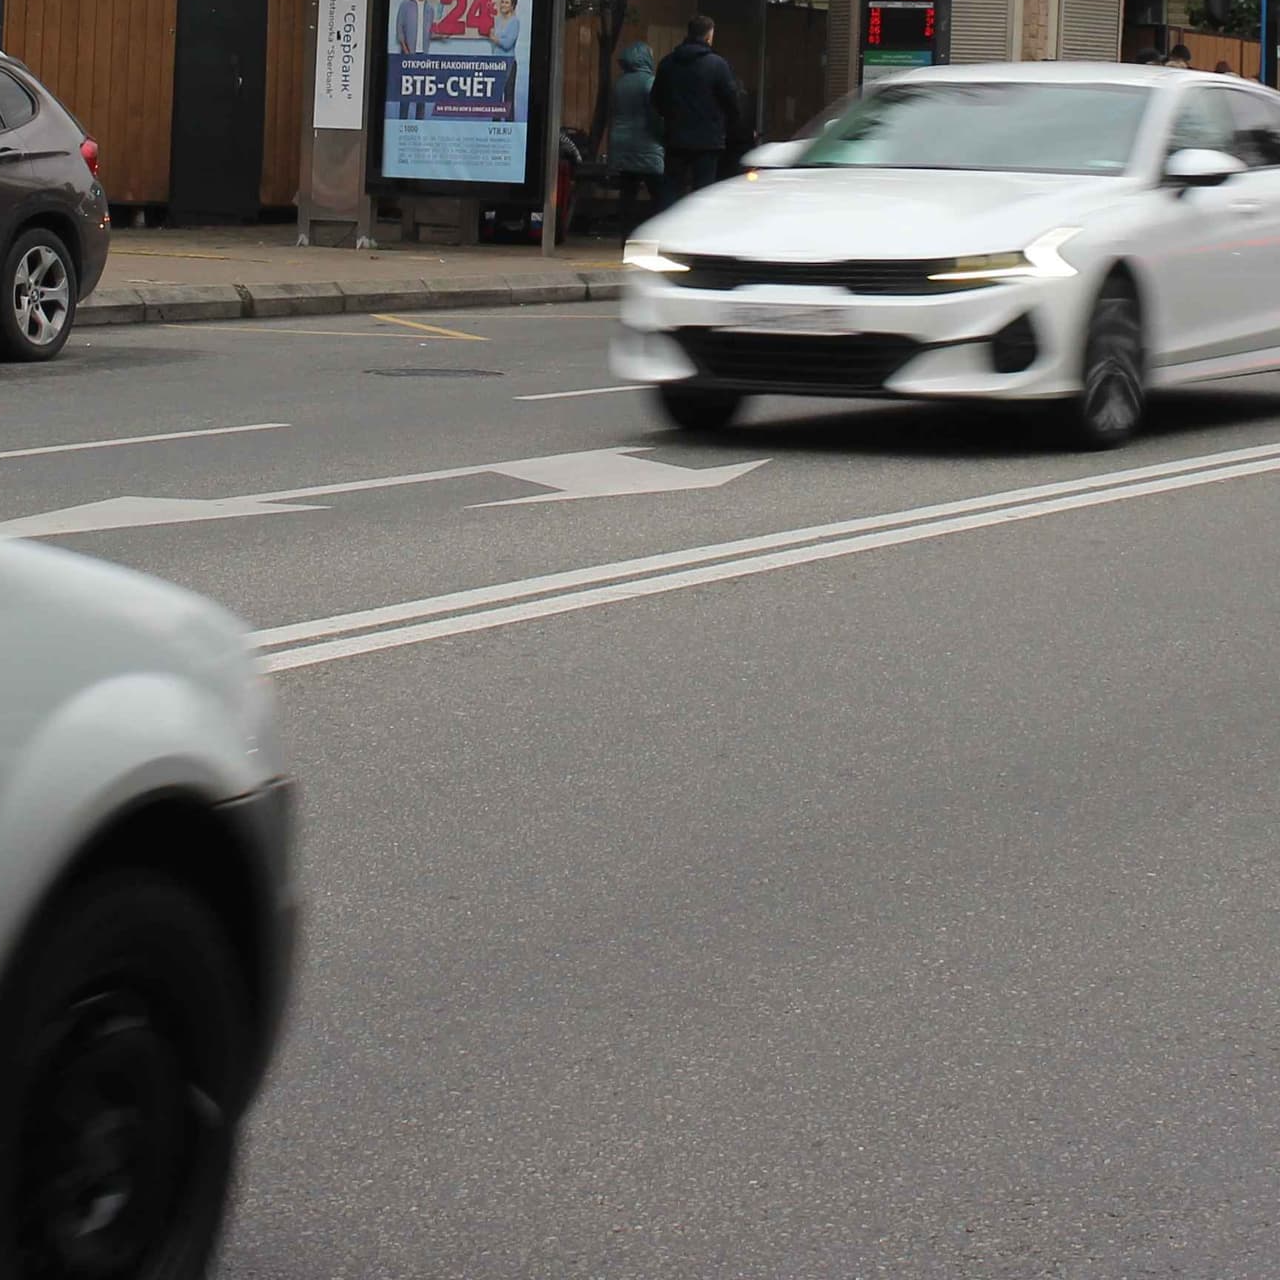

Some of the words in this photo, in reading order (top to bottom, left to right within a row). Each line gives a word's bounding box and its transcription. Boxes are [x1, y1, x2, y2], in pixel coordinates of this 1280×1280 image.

[401, 59, 440, 70] ОТКРОЙТЕ
[440, 60, 507, 71] НАКОПИТЕЛЬНЫЙ
[401, 72, 496, 97] ВТБ-СЧЁТ
